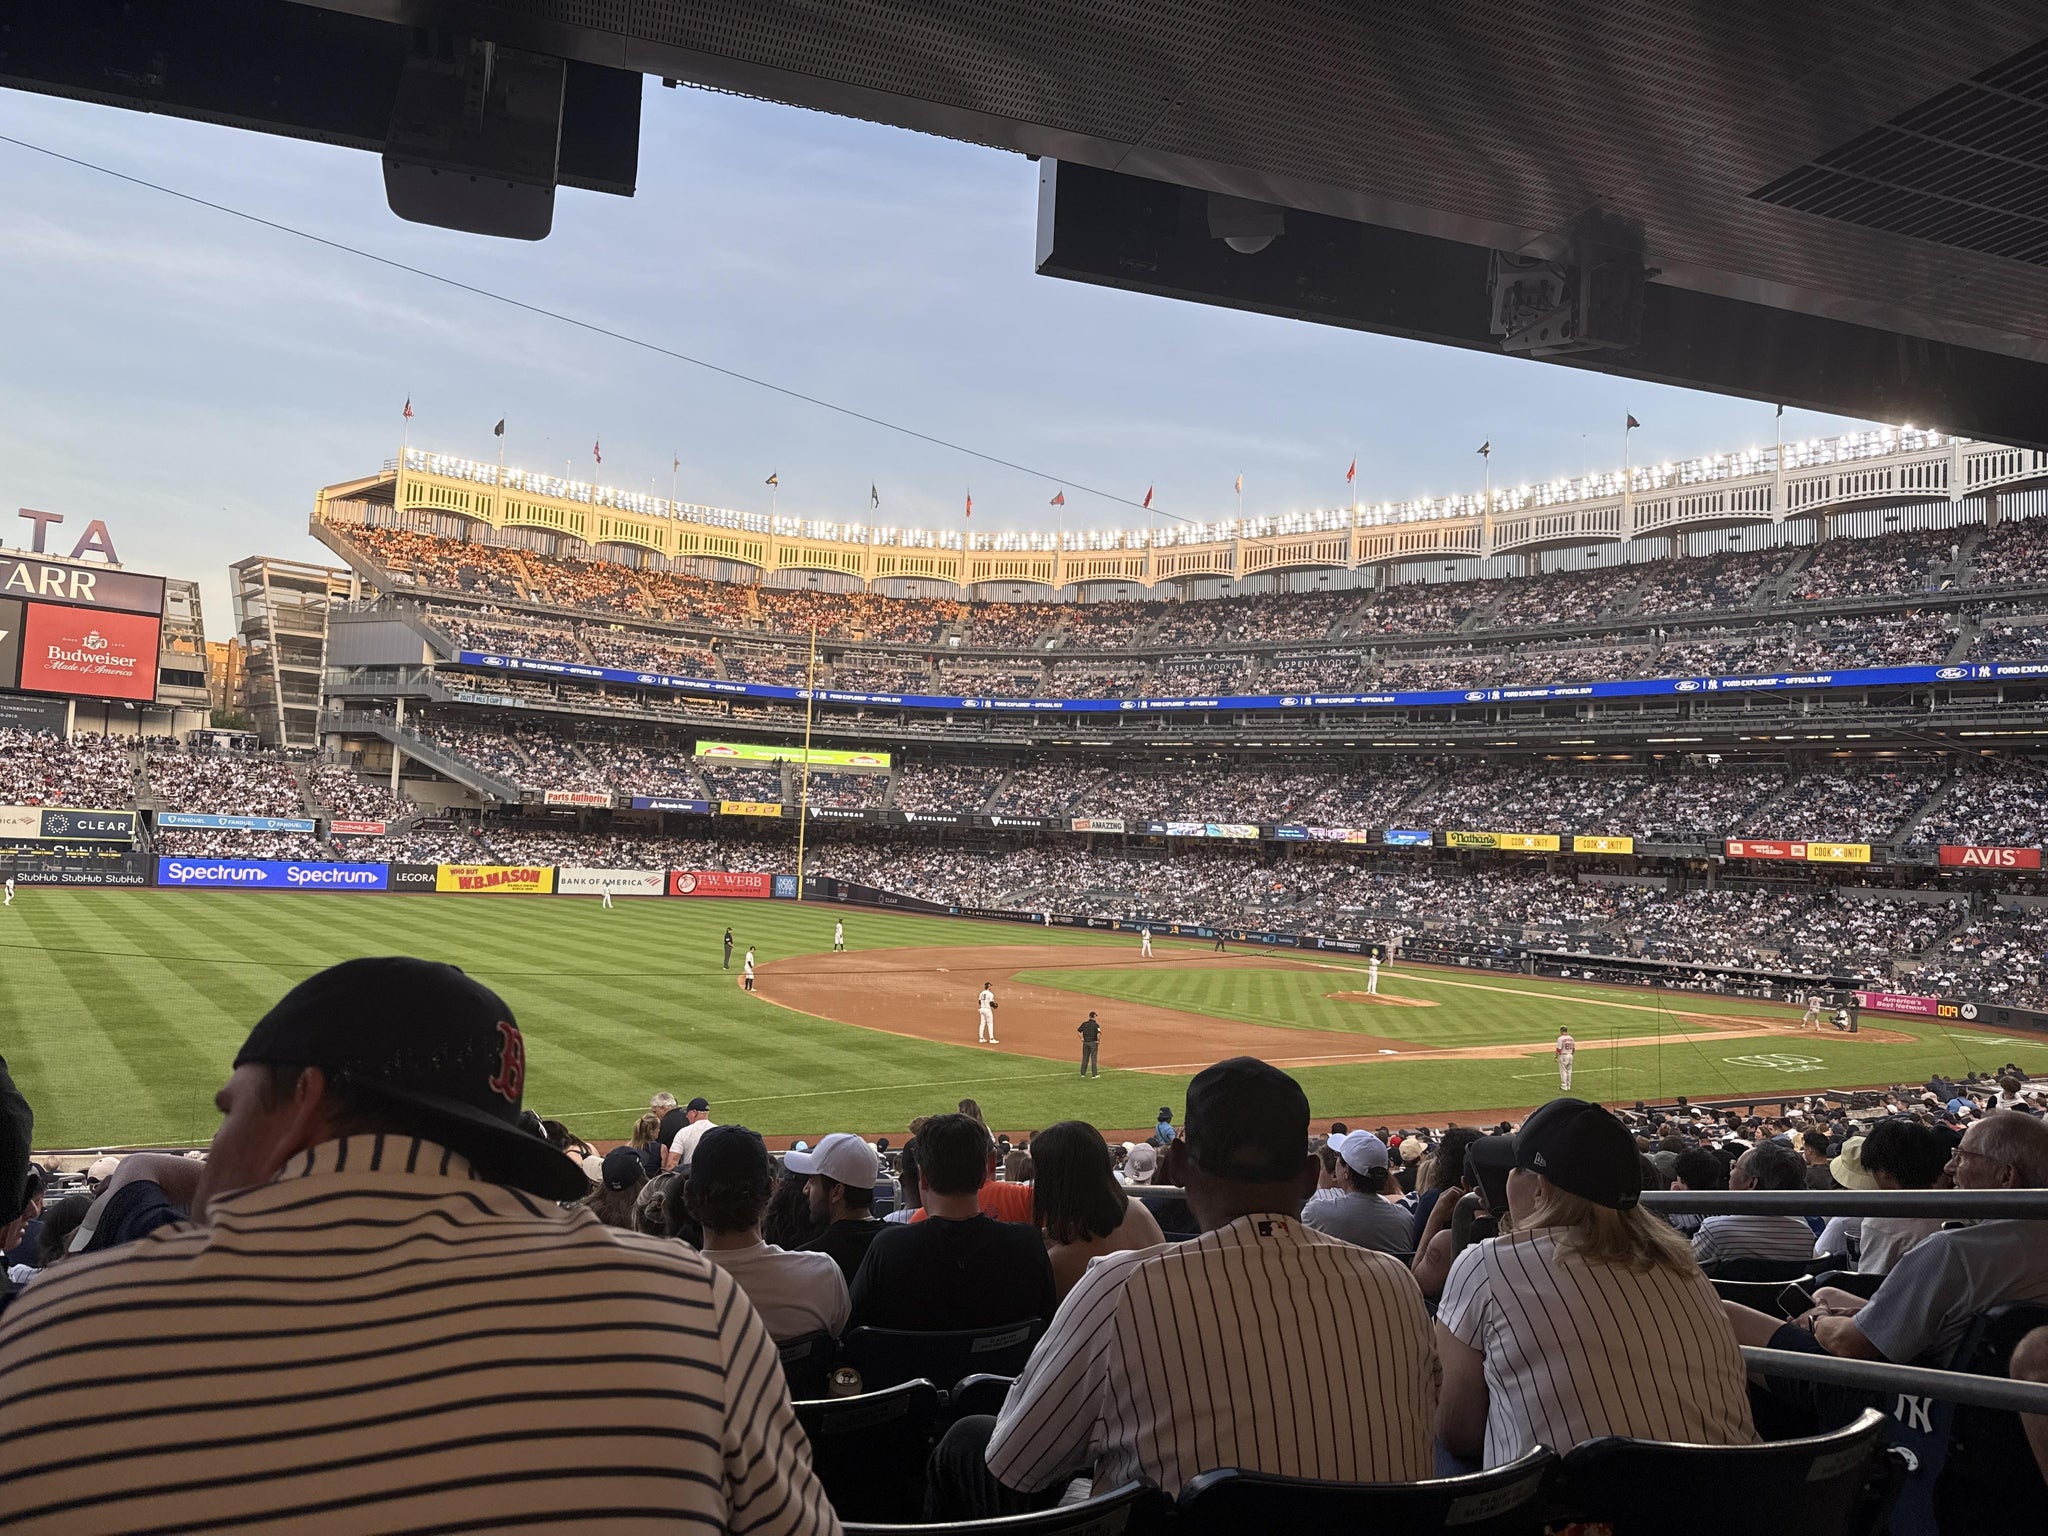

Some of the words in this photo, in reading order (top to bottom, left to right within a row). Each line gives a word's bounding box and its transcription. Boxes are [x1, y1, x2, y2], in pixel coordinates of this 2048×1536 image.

[0, 508, 119, 563] TA
[47, 645, 137, 667] Budweiser
[44, 660, 79, 672] Made
[79, 664, 92, 675] of
[89, 665, 133, 677] America
[522, 661, 537, 669] FORD
[1207, 663, 1238, 671] VODKA
[1997, 667, 2020, 675] FORD
[548, 793, 570, 801] Parts
[570, 793, 608, 803] Authority
[77, 820, 126, 831] CLEAR
[1092, 821, 1122, 830] AMAZING
[1451, 832, 1497, 845] Nathan's
[1511, 837, 1526, 846] COOK
[1533, 838, 1548, 847] UNITY
[1583, 839, 1598, 849] COOK
[1607, 841, 1623, 849] UNITY
[1814, 846, 1832, 857] COOK
[1843, 848, 1863, 858] UNITY
[1962, 848, 2016, 866] AVIS
[17, 873, 58, 882] StubHub
[61, 873, 102, 883] StubHub
[105, 874, 144, 884] StubHub
[168, 863, 261, 882] Spectrum
[287, 866, 373, 885] Spectrum
[396, 873, 436, 882] LEGORA
[602, 878, 643, 887] AMERICA
[697, 874, 720, 886] F.W.
[724, 875, 762, 887] WEBB
[1882, 996, 1922, 1005] America's
[1895, 1003, 1928, 1012] Network
[488, 1020, 526, 1103] B
